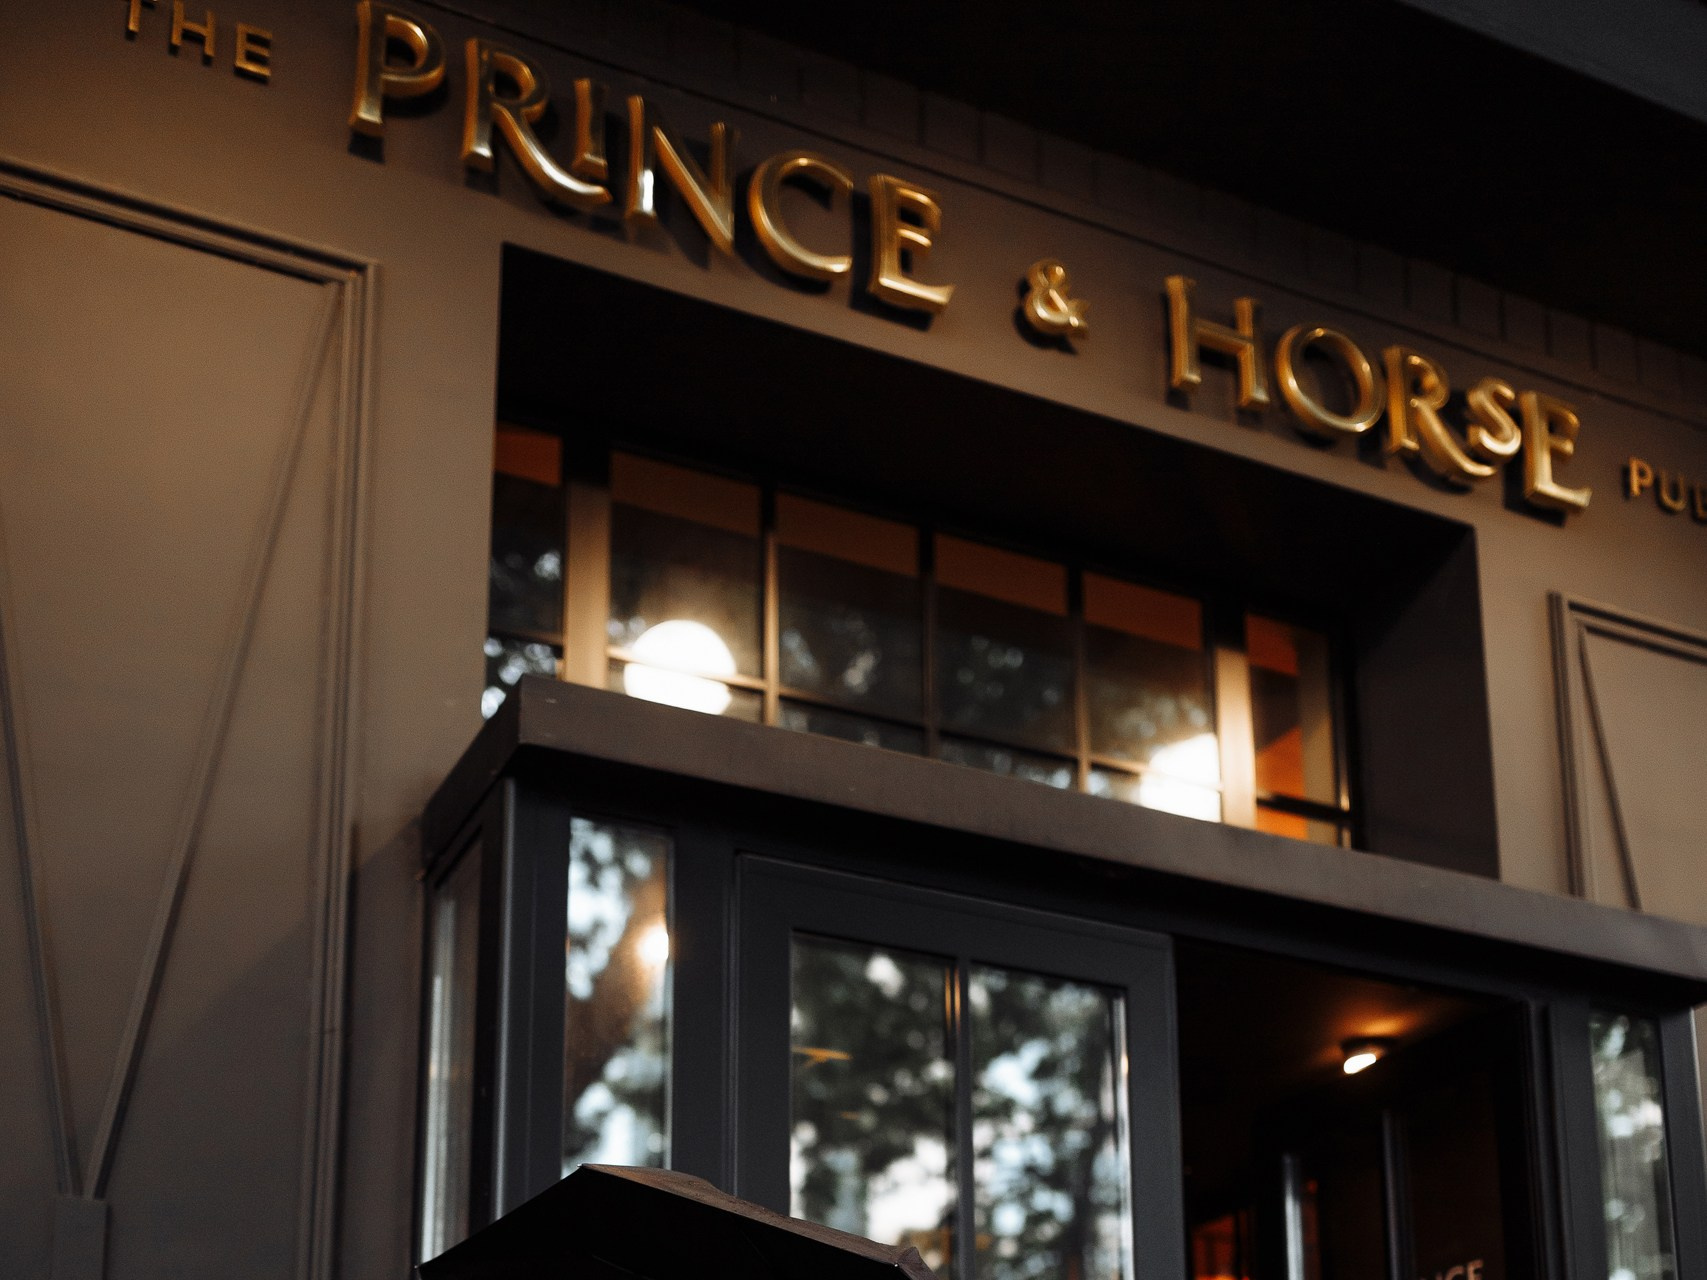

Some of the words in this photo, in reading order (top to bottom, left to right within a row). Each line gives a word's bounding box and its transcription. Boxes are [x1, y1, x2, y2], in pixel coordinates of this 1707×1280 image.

[349, 0, 954, 313] PRINCE
[1022, 257, 1088, 340] &
[1164, 274, 1592, 512] HORSE
